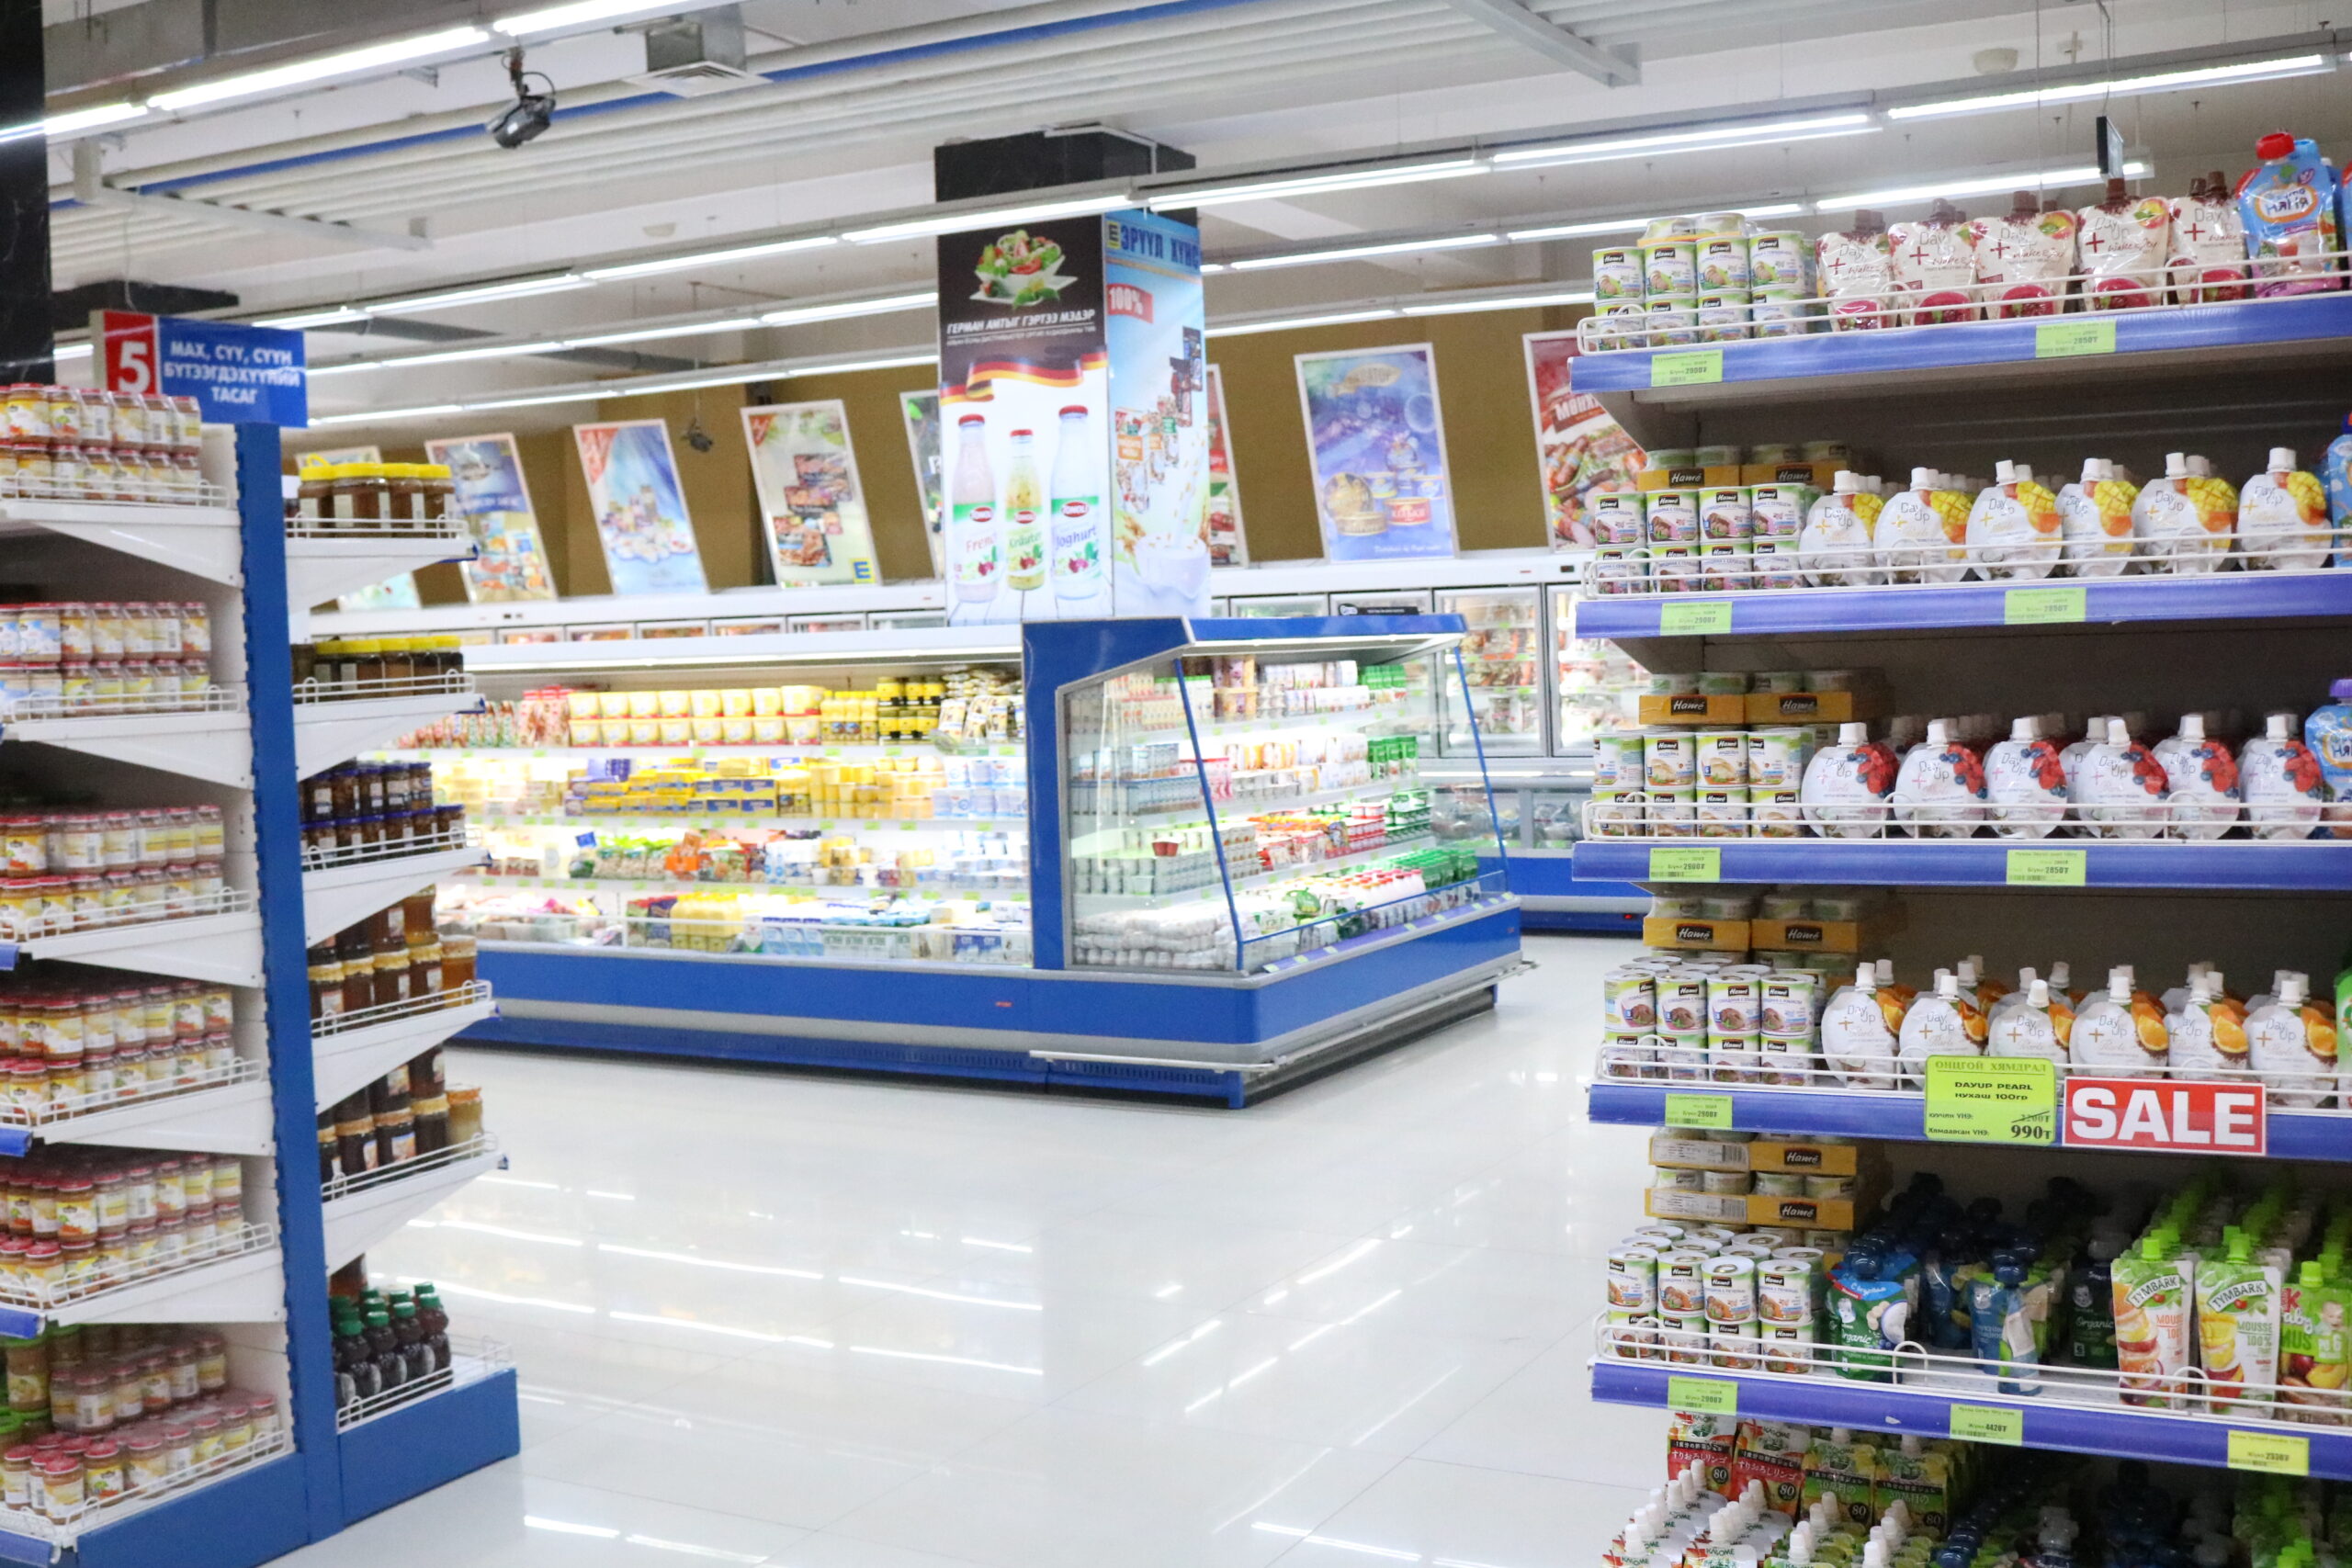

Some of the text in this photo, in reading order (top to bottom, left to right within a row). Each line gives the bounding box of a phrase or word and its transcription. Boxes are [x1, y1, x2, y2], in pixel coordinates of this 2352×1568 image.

[118, 341, 151, 395] 5
[210, 387, 258, 404] ТАСАГ
[1671, 470, 1702, 483] Hamé
[1673, 700, 1704, 710] Hamé
[1679, 927, 1710, 940] Hamé
[1935, 1060, 2046, 1073] ОНЦГОЙ ХЯМДРАЛ
[2072, 1087, 2256, 1146] SALE
[1787, 1152, 1819, 1165] Hamé
[1781, 1205, 1815, 1219] Hamé
[2131, 1276, 2177, 1304] TYMBARK
[2212, 1282, 2263, 1308] TYMBARK
[2237, 1320, 2272, 1333] MOUSSE
[2282, 1308, 2312, 1334] aby
[2247, 1335, 2272, 1347] 100%
[1713, 1469, 1727, 1480] 80
[1780, 1483, 1795, 1495] 80
[1851, 1505, 1867, 1516] 80
[1926, 1514, 1941, 1525] 80
